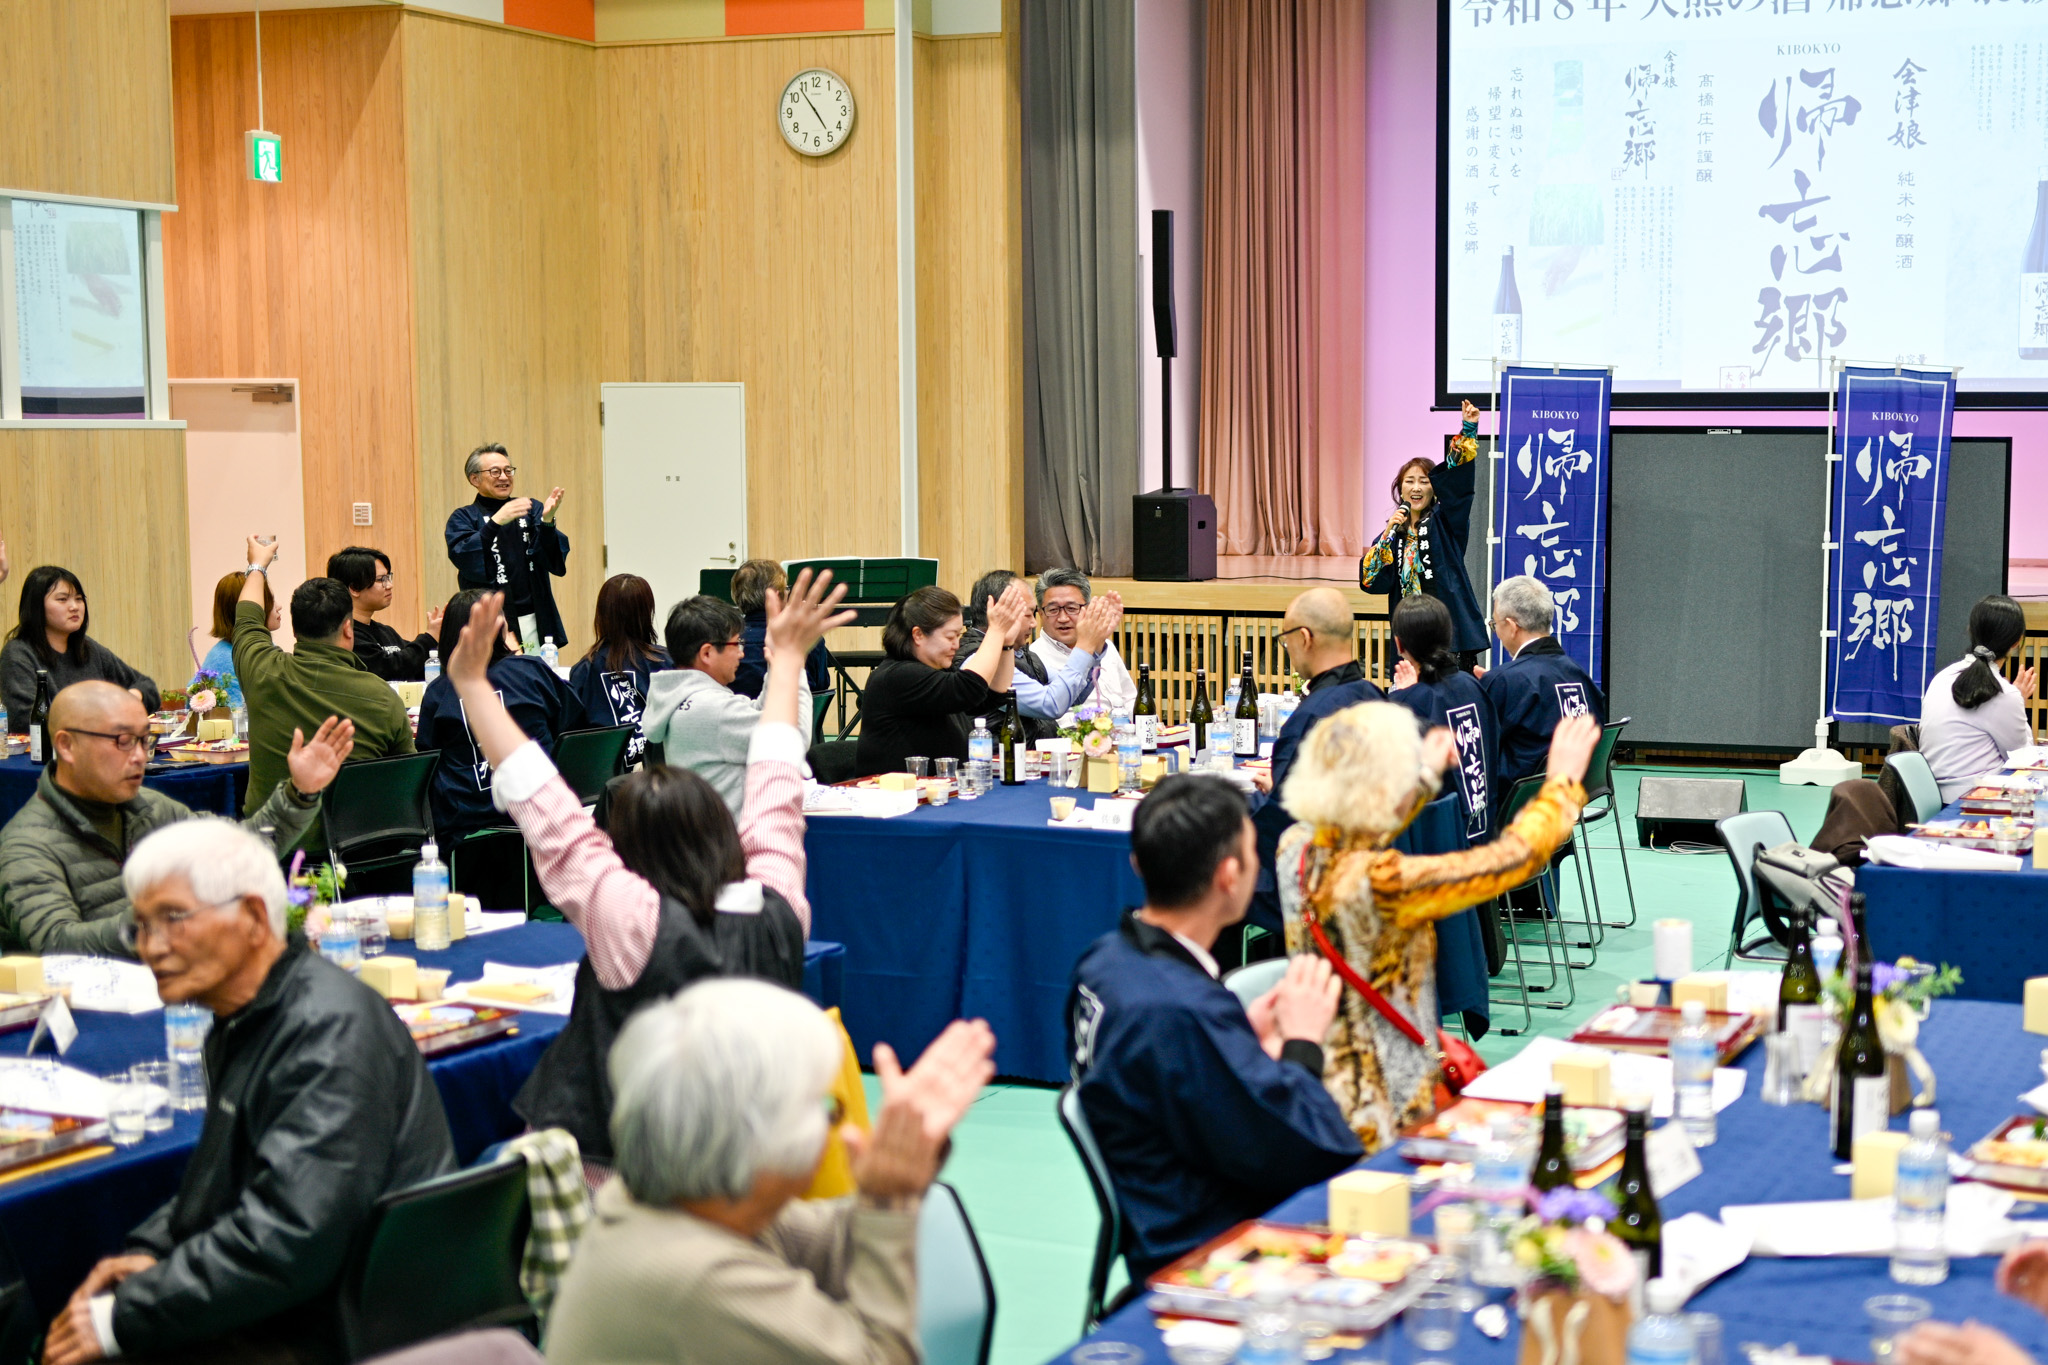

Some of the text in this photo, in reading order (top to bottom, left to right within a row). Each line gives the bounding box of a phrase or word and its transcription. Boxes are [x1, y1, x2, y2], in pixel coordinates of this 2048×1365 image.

[1777, 43, 1841, 56] KIBOKYO
[1662, 50, 1679, 89] 会津娘
[800, 81, 808, 92] 11
[811, 76, 821, 88] 12
[827, 80, 831, 91] 1
[790, 92, 800, 103] 10
[835, 90, 842, 101] 2
[1887, 57, 1929, 149] 会津娘
[786, 107, 793, 118] 9
[840, 105, 847, 117] 3
[792, 122, 799, 133] 8
[836, 120, 842, 131] 4
[1510, 67, 1524, 179] 忘れぬ想いを
[1623, 63, 1660, 181] 帰忘郷
[802, 132, 808, 143] 7
[813, 136, 820, 147] 6
[827, 131, 834, 142] 5
[1487, 86, 1502, 198] 帰望に変えて
[1464, 106, 1480, 256] 感謝の酒 帰忘郷
[1895, 170, 1915, 270] 純米吟醸酒
[1752, 67, 1862, 388] 帰忘郷
[1532, 410, 1580, 420] KIBOKYO
[1871, 411, 1919, 423] KIBOKYO
[1418, 518, 1433, 579] おおくま
[1844, 430, 1932, 682] 帰忘郷
